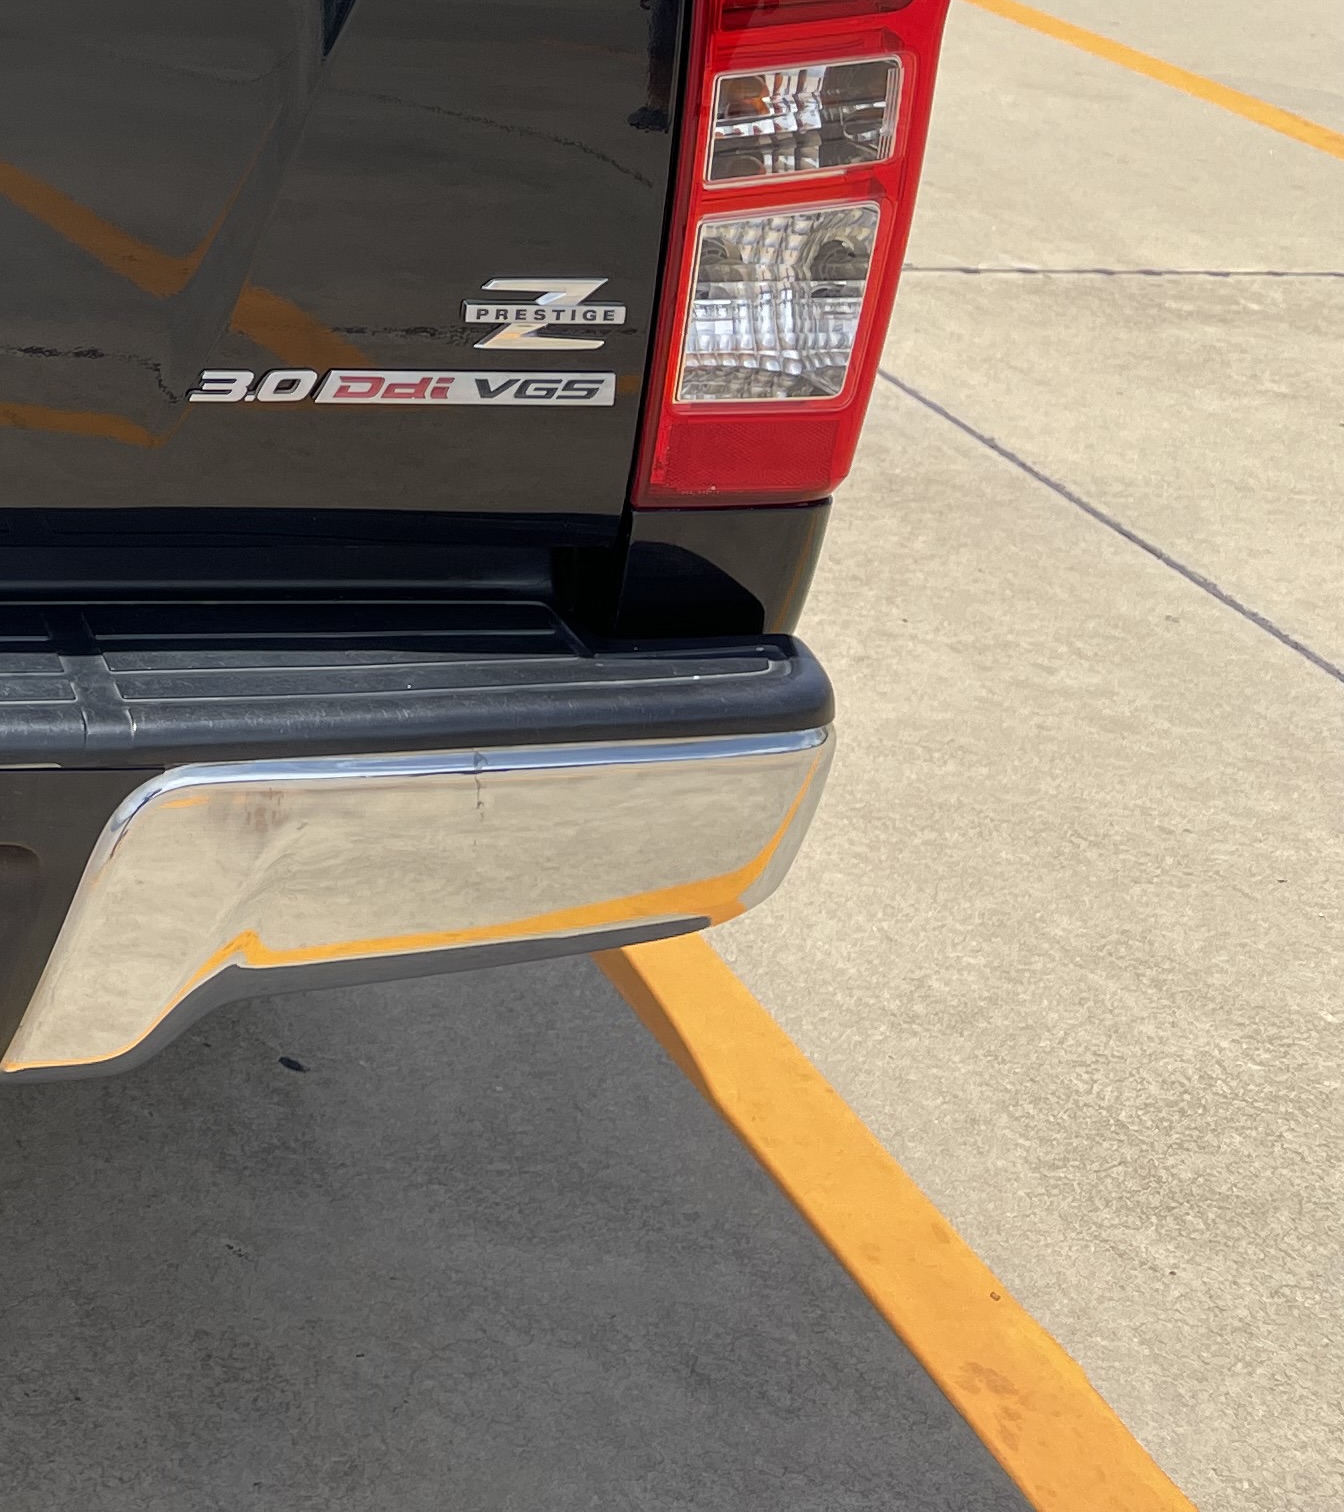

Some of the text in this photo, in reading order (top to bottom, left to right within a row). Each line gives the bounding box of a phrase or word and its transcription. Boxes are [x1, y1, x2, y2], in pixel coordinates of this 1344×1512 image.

[475, 308, 616, 322] PRESTIGE
[188, 369, 604, 402] 3.0 Ddi VGS
